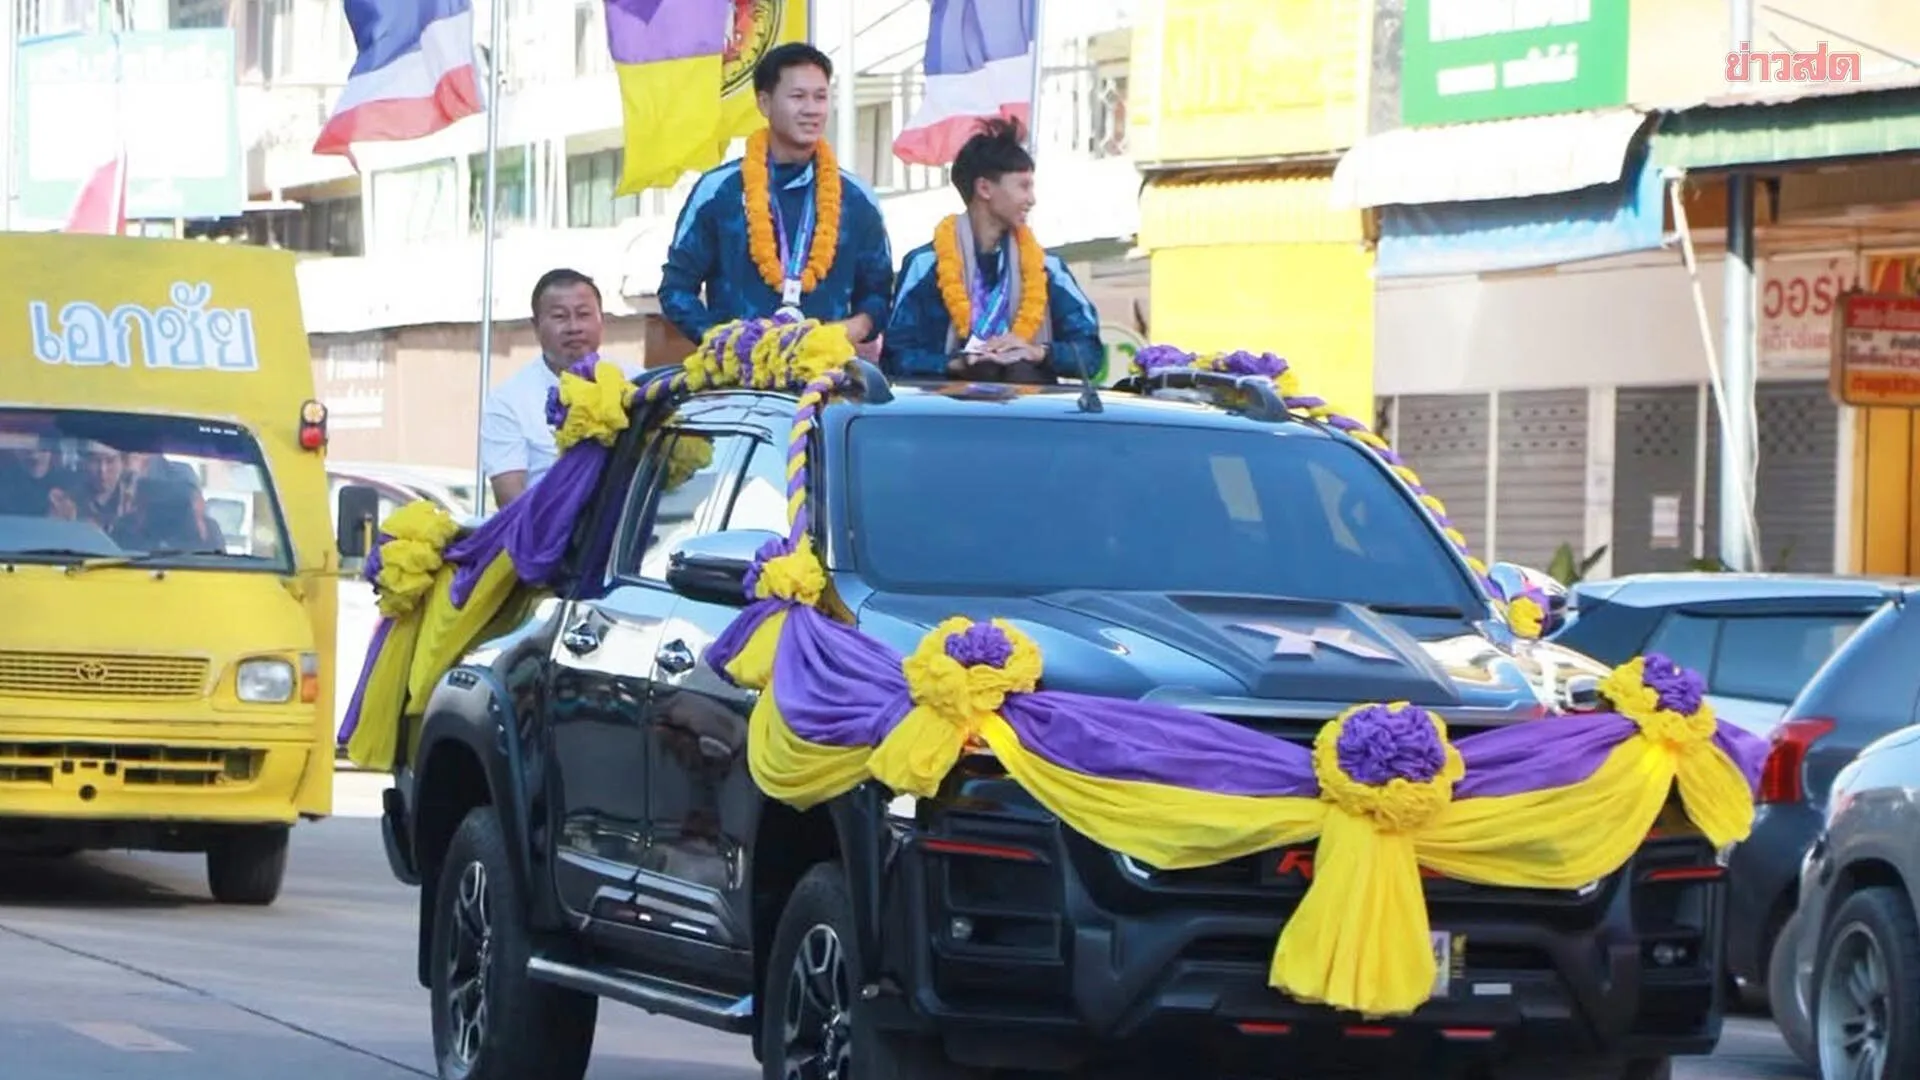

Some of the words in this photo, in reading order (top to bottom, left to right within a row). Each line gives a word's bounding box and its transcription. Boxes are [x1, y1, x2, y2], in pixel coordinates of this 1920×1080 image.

[29, 281, 260, 371] เอกชัย
[1764, 258, 1844, 319] วอร์
